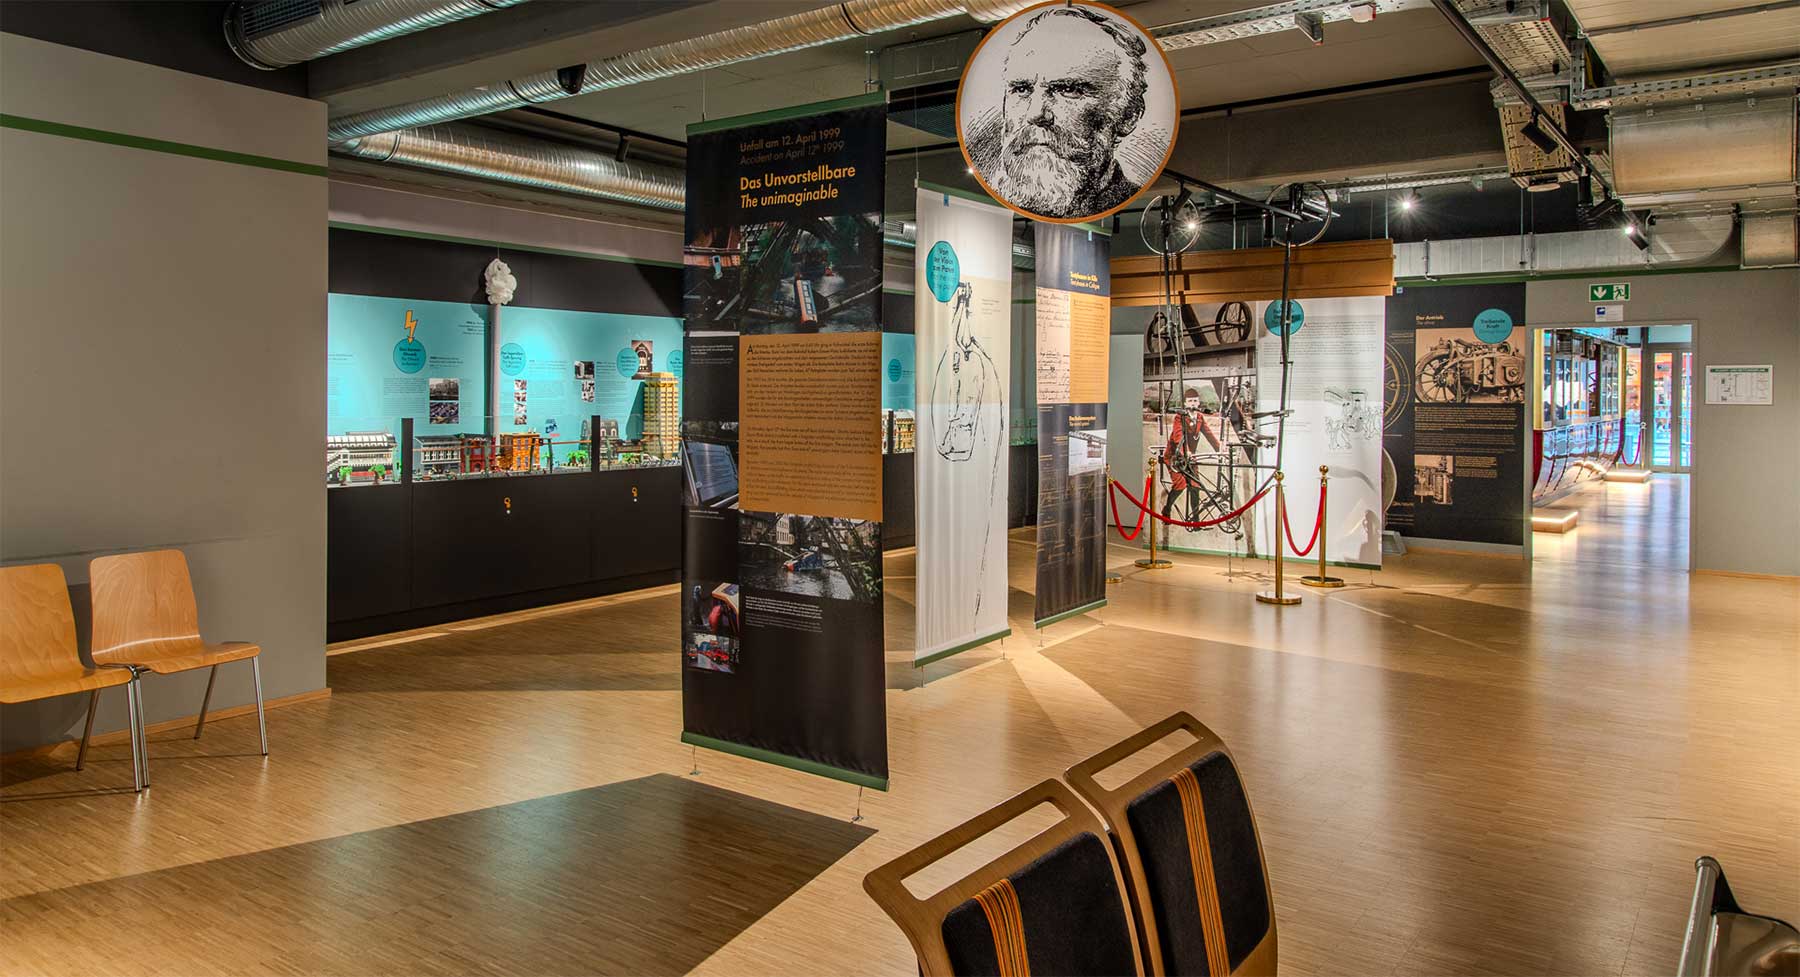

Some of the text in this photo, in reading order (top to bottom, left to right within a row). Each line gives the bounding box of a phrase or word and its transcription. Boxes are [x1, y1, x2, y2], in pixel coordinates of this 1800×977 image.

[740, 127, 841, 152] Unfall am 12. April 1999
[740, 152, 773, 165] Accident
[774, 152, 784, 160] on
[785, 144, 806, 160] April
[823, 140, 845, 152] 1999
[740, 164, 856, 191] Das Unvorstellbare
[740, 183, 839, 209] The unimaginable
